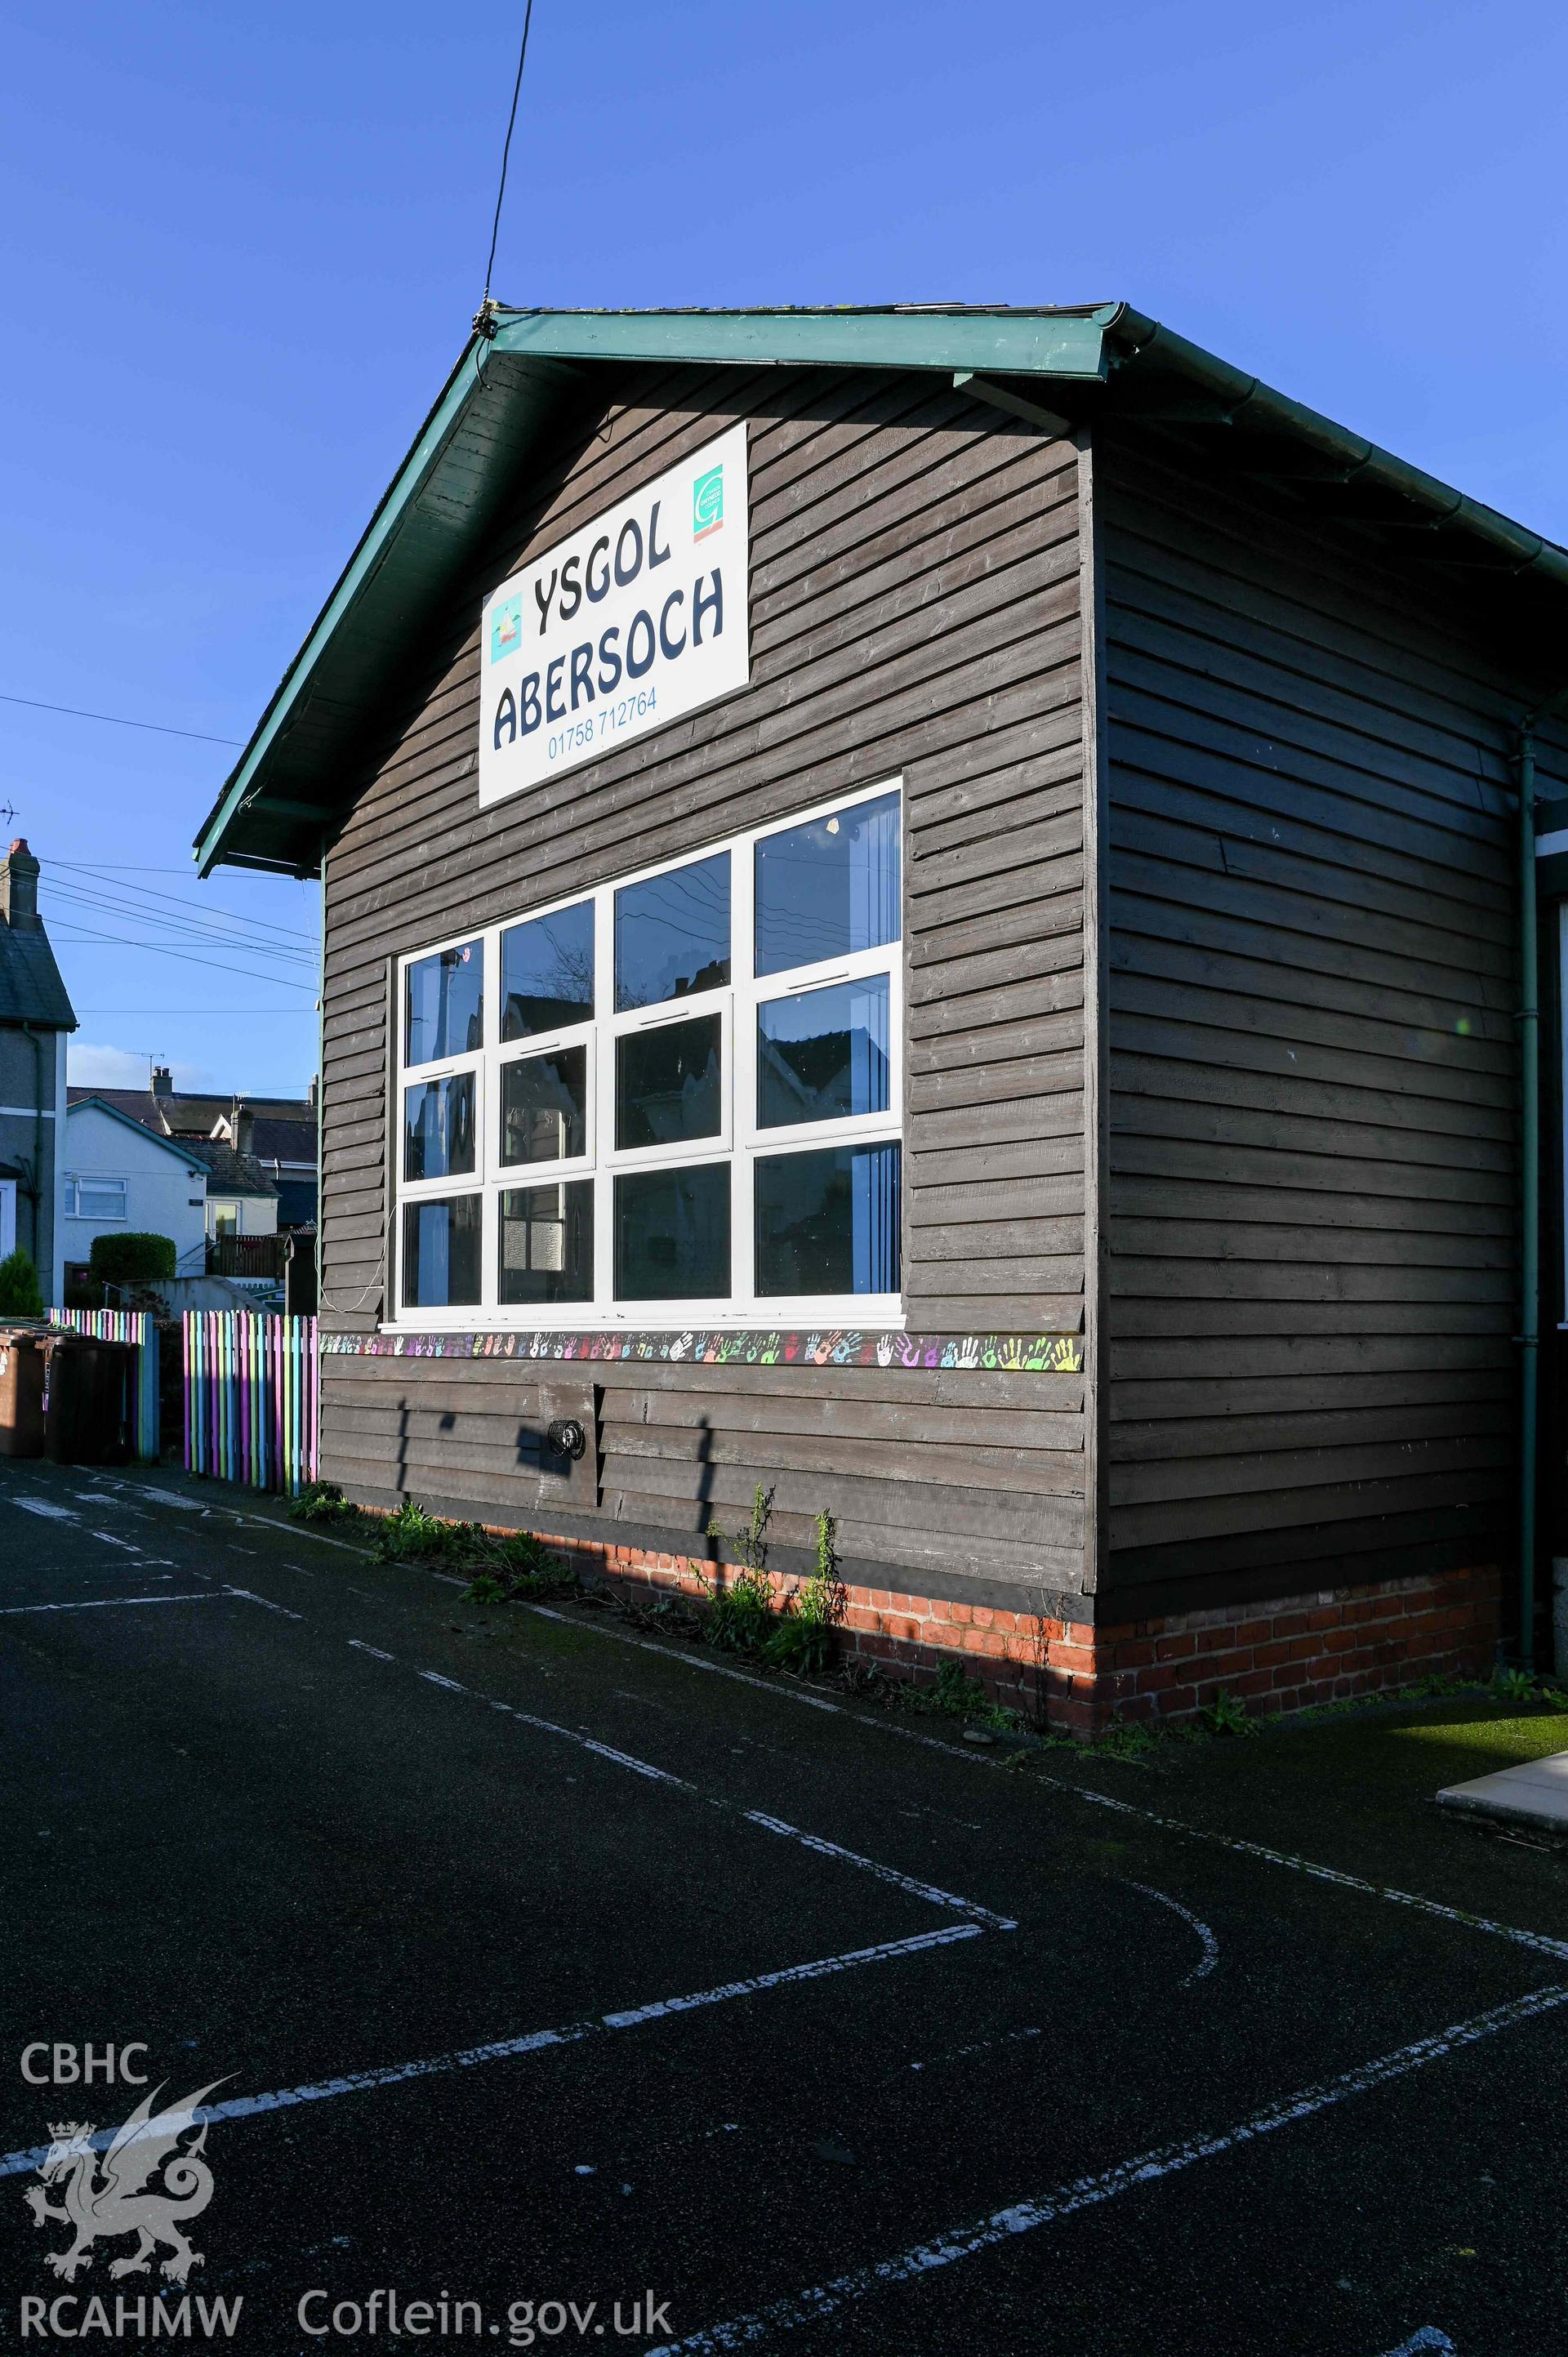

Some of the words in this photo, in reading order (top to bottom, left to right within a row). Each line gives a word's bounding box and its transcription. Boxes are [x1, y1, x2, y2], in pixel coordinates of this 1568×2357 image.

[534, 501, 671, 637] YSGOL
[493, 568, 724, 751] ABERSOCH
[548, 718, 594, 760] 01758
[598, 686, 657, 736] 712764
